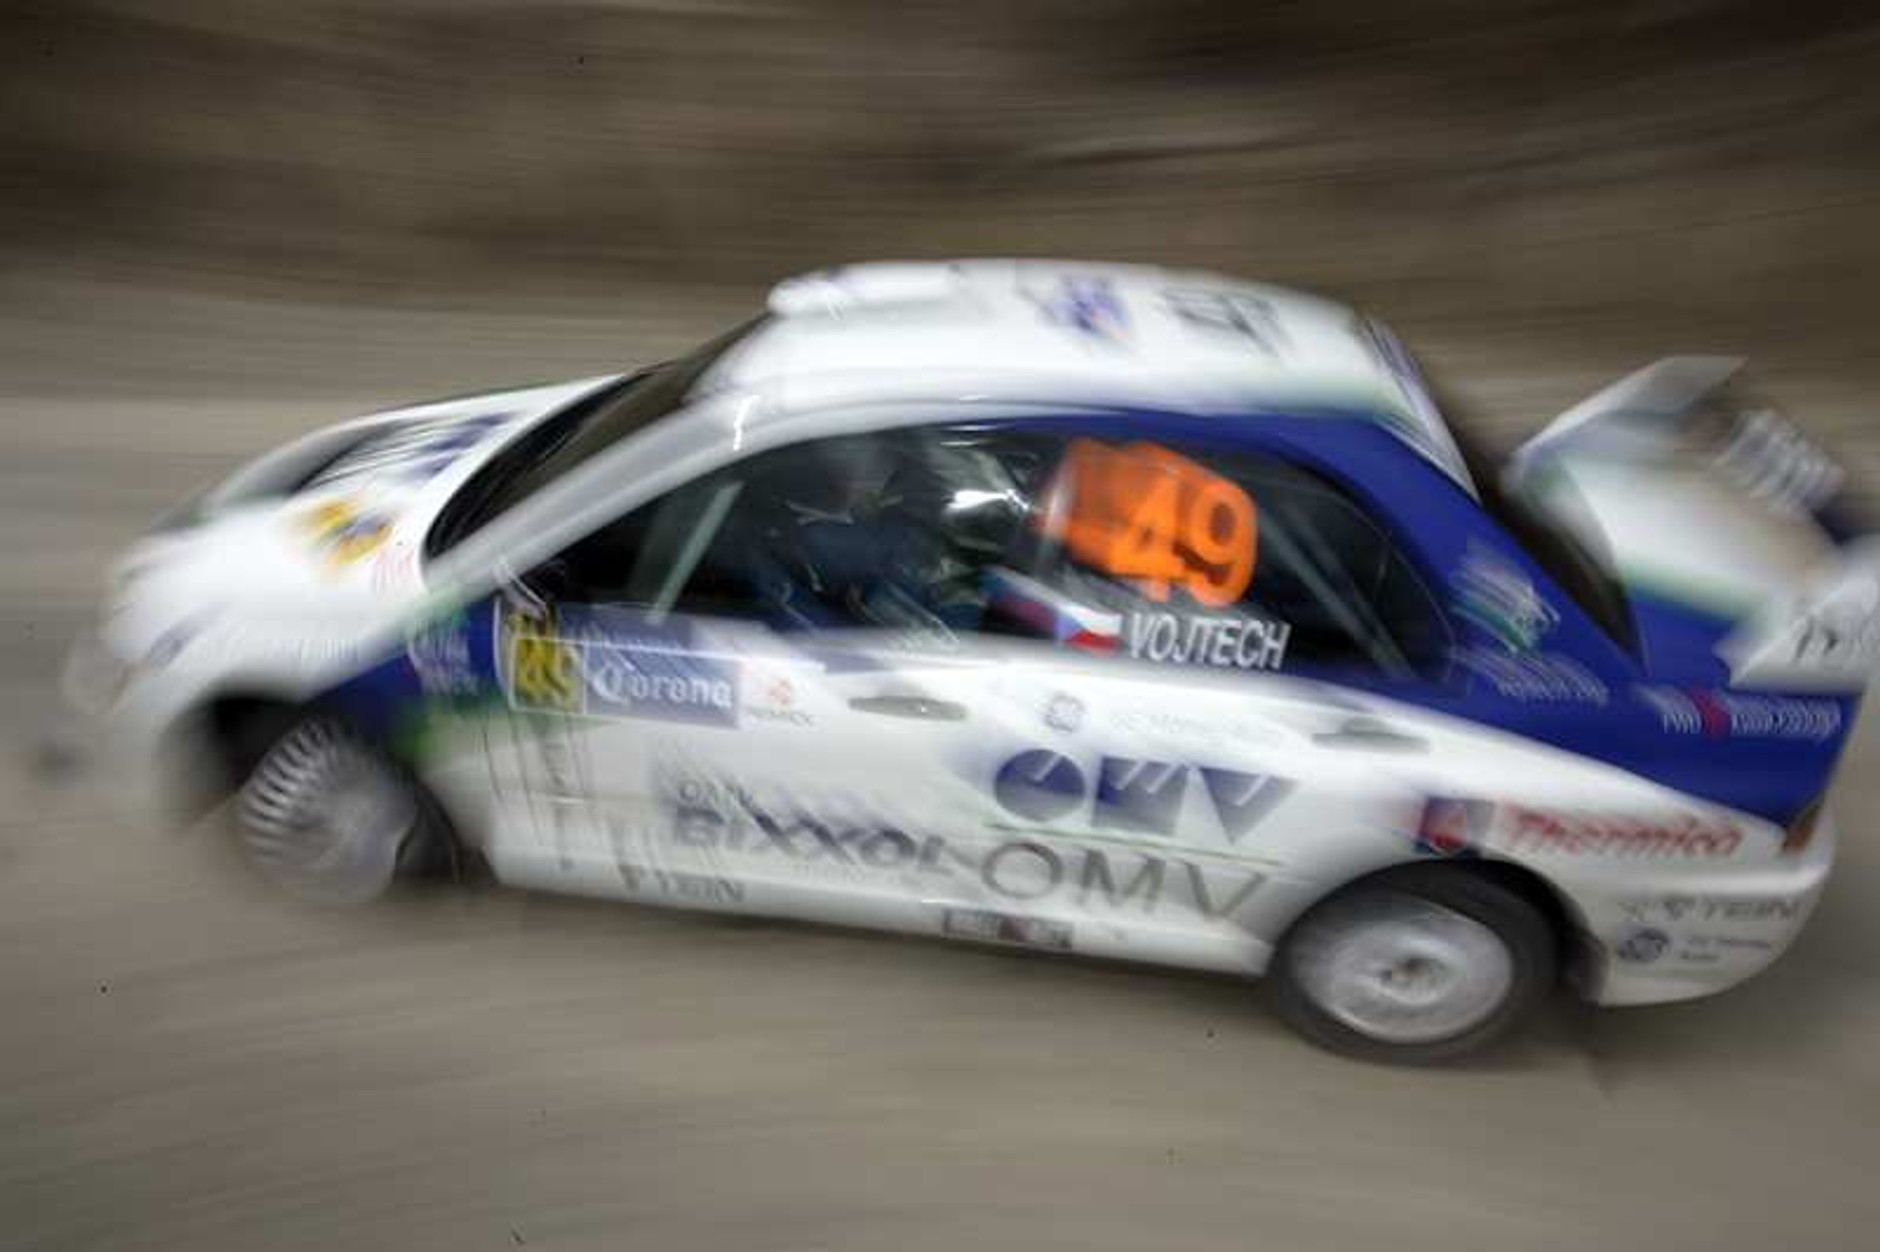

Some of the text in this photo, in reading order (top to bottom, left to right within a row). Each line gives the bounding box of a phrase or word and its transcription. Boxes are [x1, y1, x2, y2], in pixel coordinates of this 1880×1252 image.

[1106, 474, 1257, 609] 49
[1128, 612, 1292, 671] VOJTECH
[589, 654, 733, 712] Corona
[981, 841, 1268, 920] OMV
